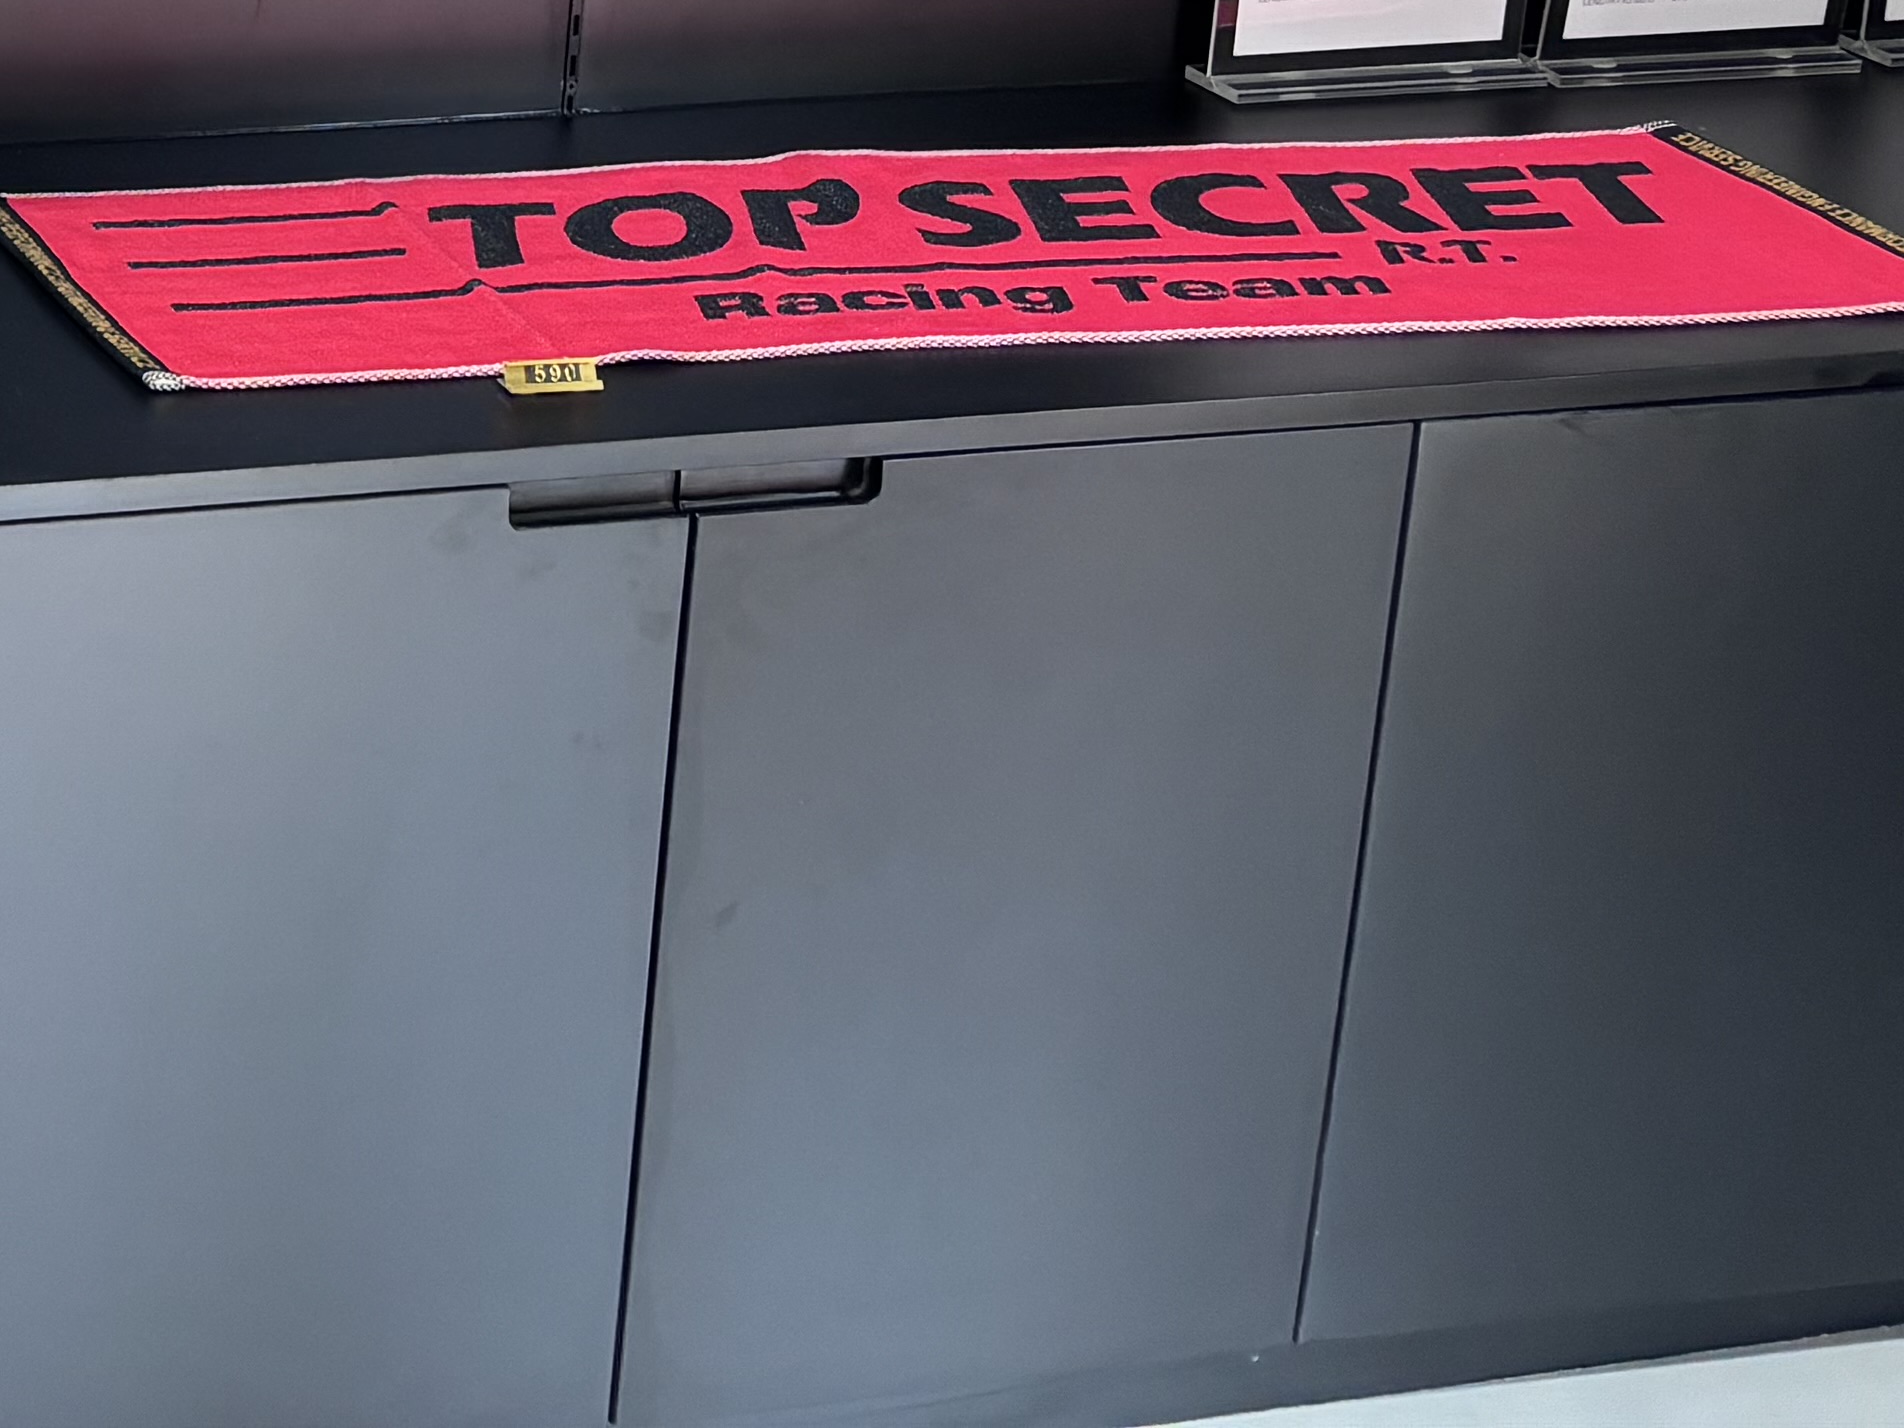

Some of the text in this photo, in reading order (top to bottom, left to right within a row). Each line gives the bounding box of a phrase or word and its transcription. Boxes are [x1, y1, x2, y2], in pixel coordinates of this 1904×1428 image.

[427, 177, 861, 270] TOP
[897, 160, 1666, 248] SECRET
[1374, 238, 1519, 267] R.T.
[693, 274, 1395, 322] Racing Team
[533, 361, 578, 384] 590
